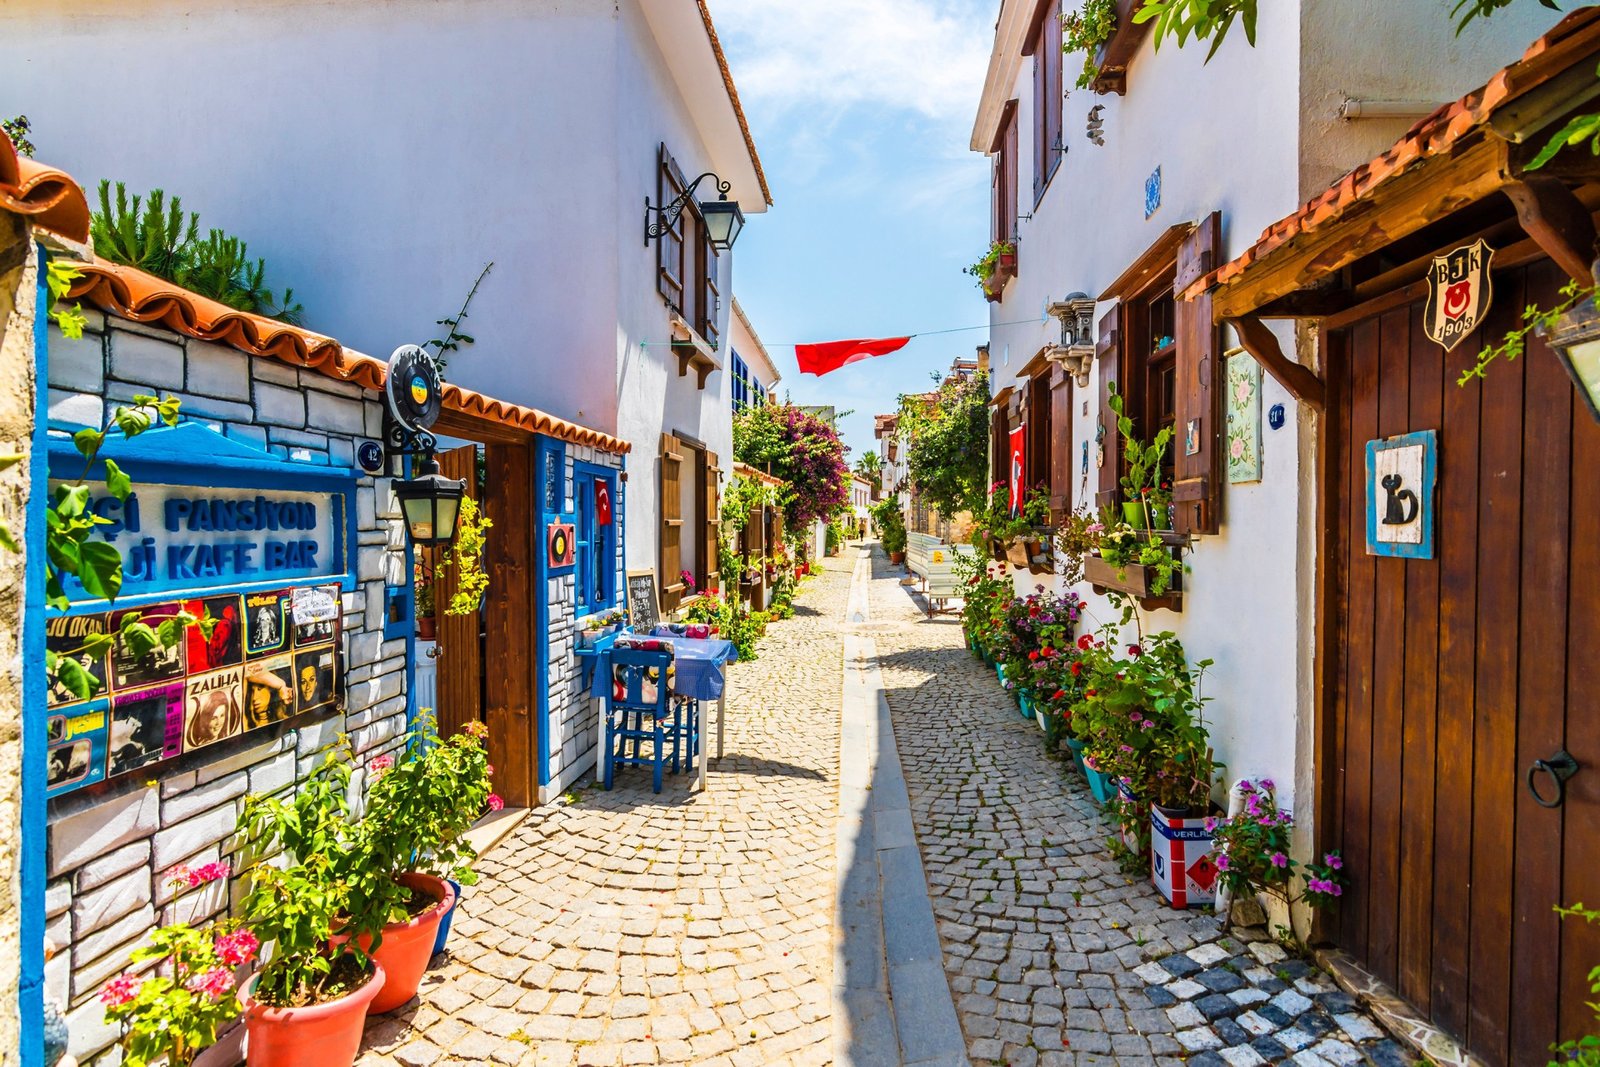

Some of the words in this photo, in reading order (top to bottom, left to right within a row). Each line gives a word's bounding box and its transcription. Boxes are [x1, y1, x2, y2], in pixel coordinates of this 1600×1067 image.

[1438, 250, 1481, 284] BJK
[1438, 317, 1474, 339] 1903
[367, 448, 378, 461] 42
[164, 496, 317, 532] PANSİYON
[167, 543, 258, 580] KAFE
[264, 540, 319, 571] BAR
[68, 616, 103, 637] OKAN
[190, 671, 239, 696] ZALİHA
